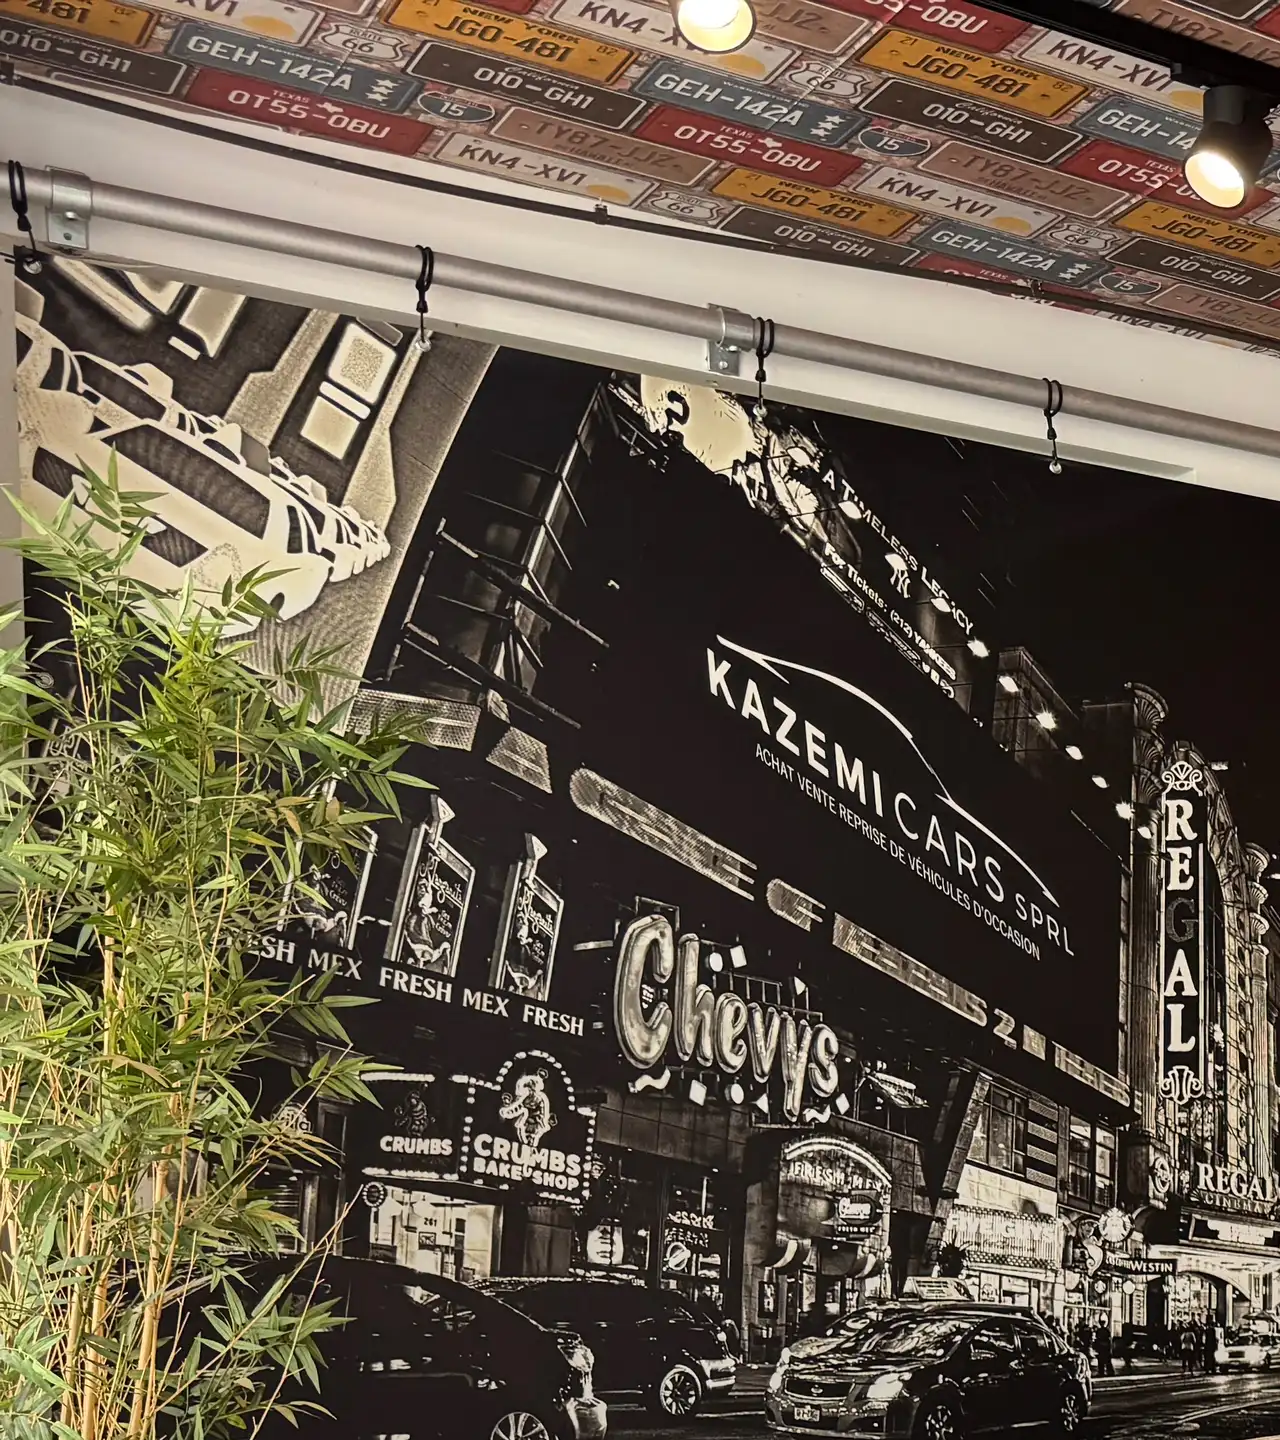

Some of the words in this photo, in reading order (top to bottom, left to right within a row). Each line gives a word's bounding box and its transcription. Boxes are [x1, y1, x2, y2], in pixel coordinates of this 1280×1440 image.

[188, 34, 353, 91] GEH-142A
[339, 34, 377, 54] 66
[652, 72, 805, 126] GEH-142A
[803, 72, 840, 91] 66
[437, 100, 468, 117] 15
[874, 135, 905, 152] 15
[665, 199, 698, 214] 66
[928, 229, 1058, 271] GEH-142A
[1061, 231, 1094, 245] 66
[707, 647, 883, 817] KAZEMI
[894, 792, 1005, 903] CARS
[1015, 893, 1074, 956] SPRL
[755, 743, 795, 783] ACHAT
[798, 770, 837, 815] VENTE
[838, 801, 888, 852] REPRISE
[890, 839, 907, 865] DE
[908, 854, 972, 912] VÉHICULES
[973, 901, 1041, 962] D'OCCASION
[1165, 799, 1198, 1053] REGAL
[308, 949, 363, 981] MEX
[378, 967, 452, 1004] FRESH
[462, 988, 509, 1017] MEX
[523, 1006, 584, 1037] FRESH
[615, 914, 839, 1123] Chevys
[380, 1135, 453, 1157] CRUMBS
[474, 1133, 581, 1177] CRUMBS
[1197, 1161, 1279, 1202] REGAL
[1130, 1258, 1173, 1274] WESTIN
